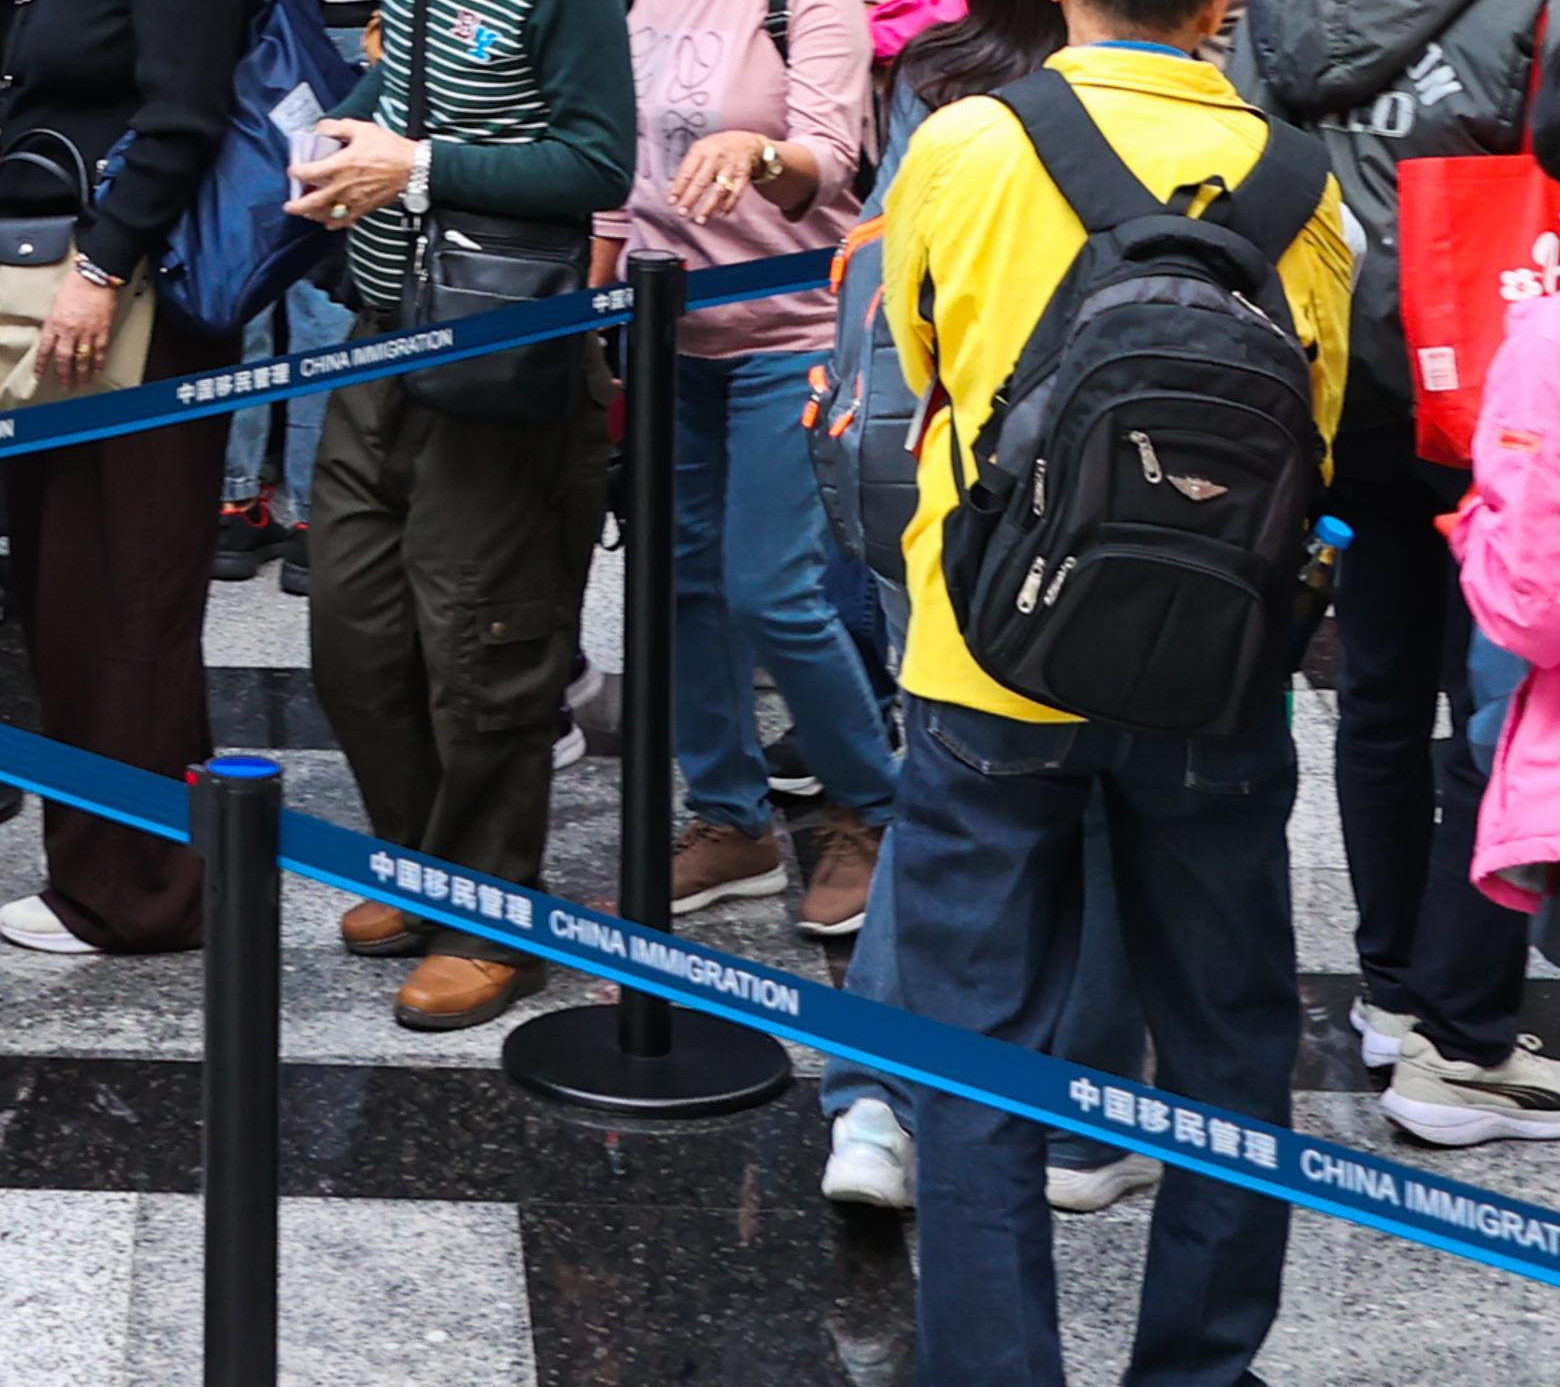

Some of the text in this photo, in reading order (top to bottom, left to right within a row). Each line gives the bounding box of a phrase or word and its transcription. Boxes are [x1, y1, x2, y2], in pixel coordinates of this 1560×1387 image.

[299, 351, 349, 379] CHINA
[352, 328, 454, 370] IMMIGRATION
[370, 851, 800, 1017] 中国移民管理 CHINA IMMIGRATION
[1070, 1077, 1279, 1169] 中国移民管理
[1300, 1148, 1399, 1208] CHINA
